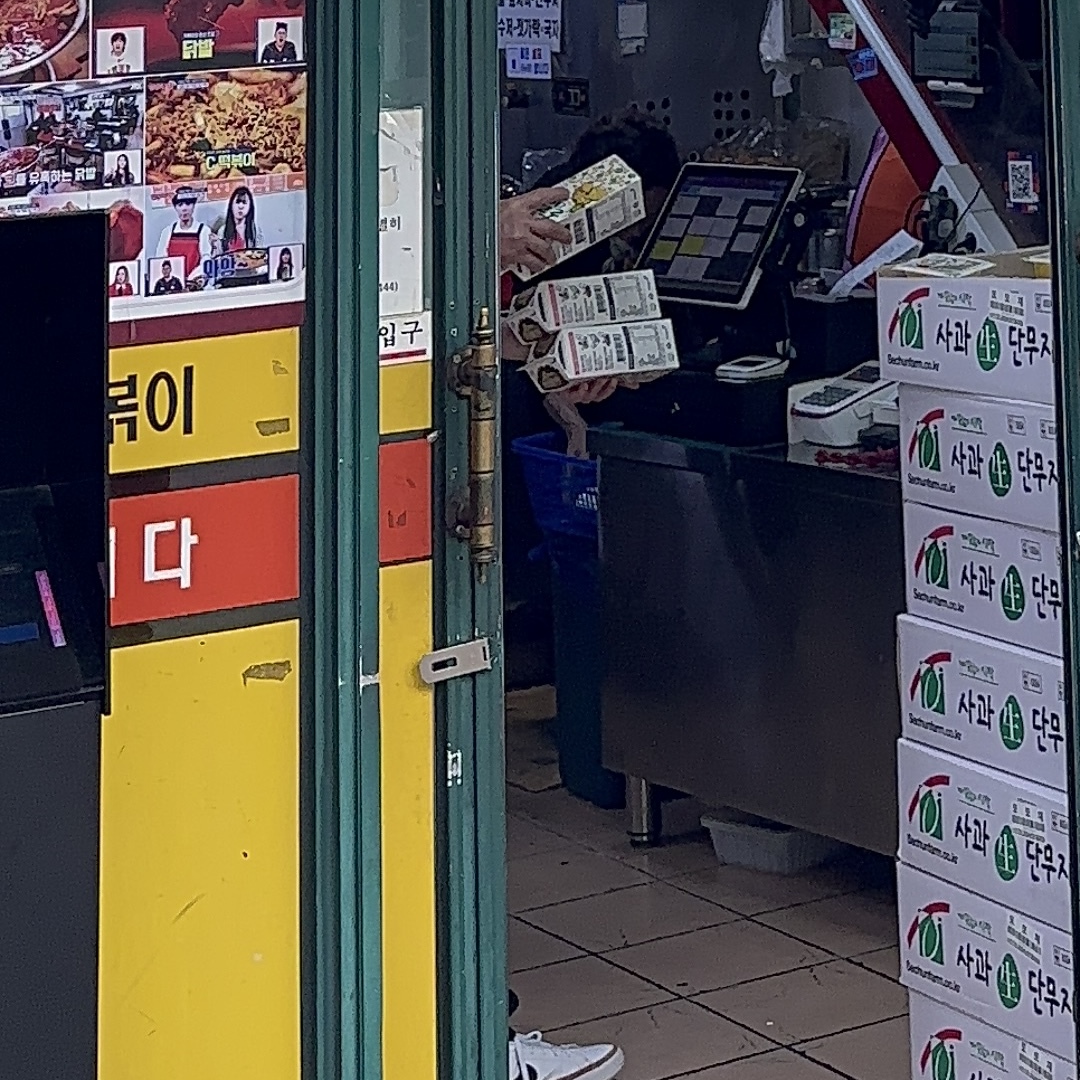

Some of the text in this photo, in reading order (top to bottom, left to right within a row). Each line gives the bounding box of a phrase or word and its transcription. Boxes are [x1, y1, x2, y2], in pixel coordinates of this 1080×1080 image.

[936, 317, 971, 356] 사과
[951, 441, 984, 480] 사과
[961, 560, 996, 603] 사과
[958, 689, 995, 732] 사과
[954, 812, 990, 858] 사과
[956, 942, 993, 988] 사과
